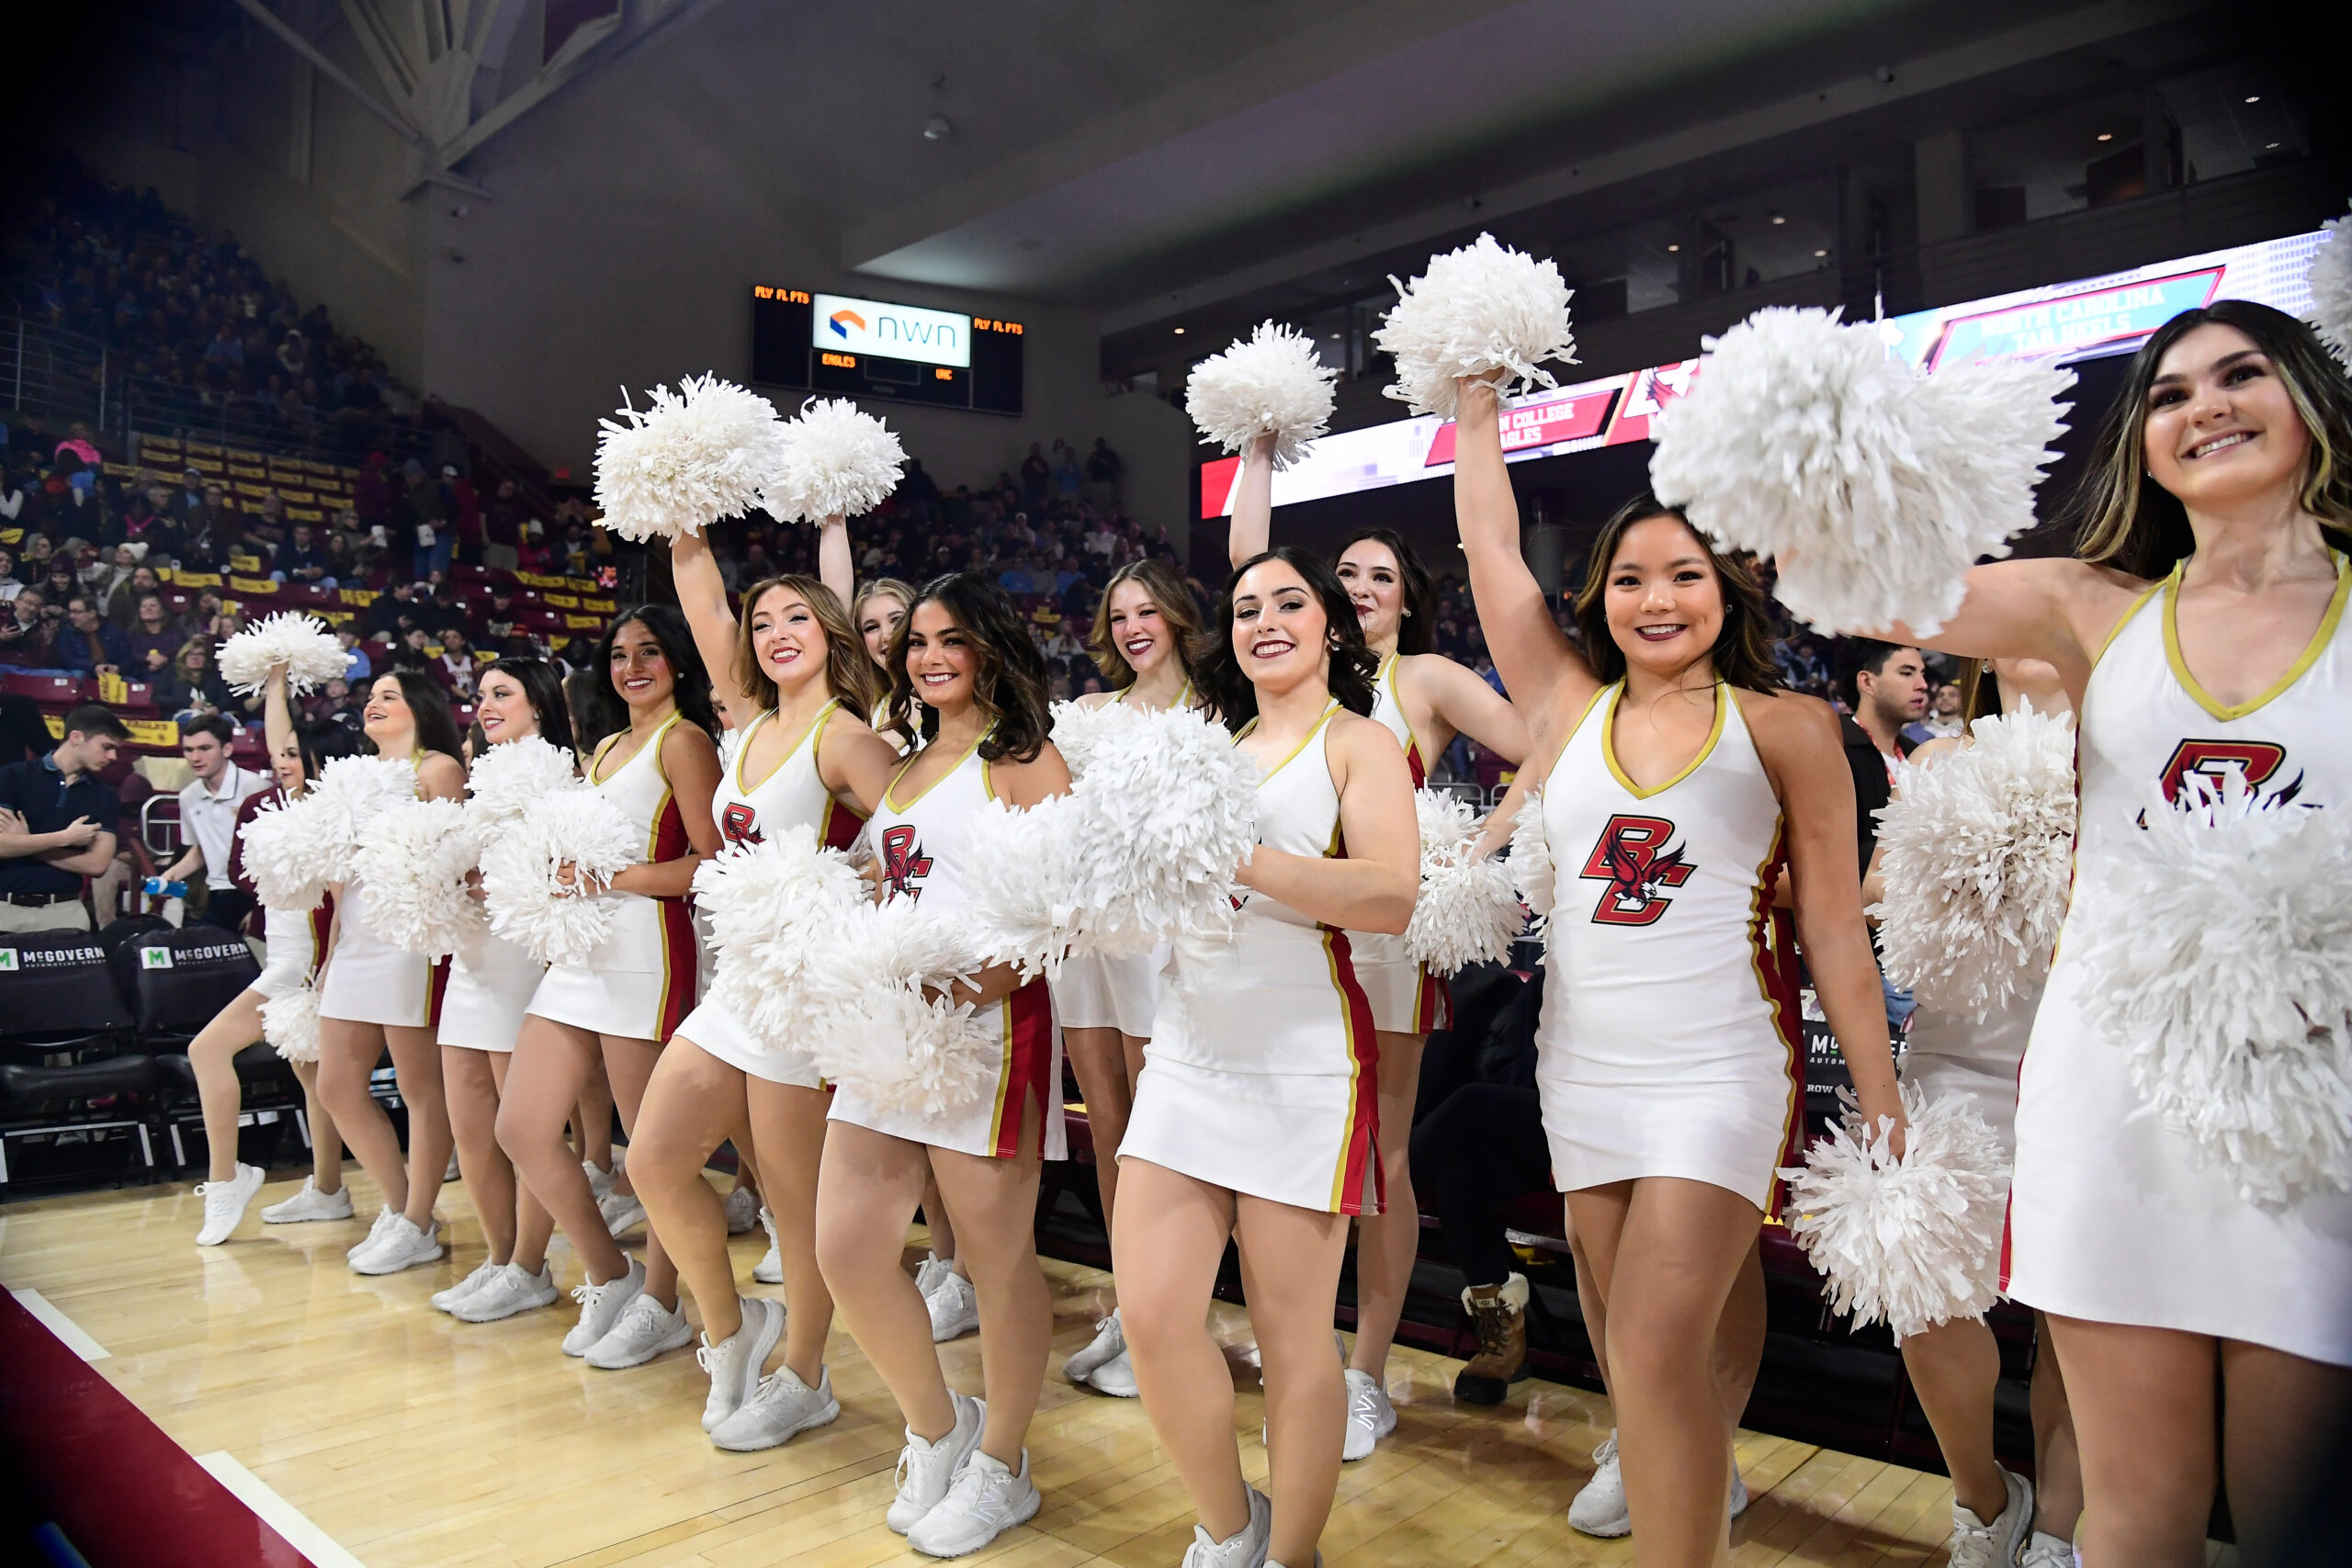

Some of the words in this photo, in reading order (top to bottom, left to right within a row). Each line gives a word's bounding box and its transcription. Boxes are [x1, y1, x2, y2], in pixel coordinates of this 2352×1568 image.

[790, 290, 809, 304] PTS
[1981, 309, 2051, 338] NORTH
[2056, 286, 2165, 321] CAROLINA
[878, 316, 956, 348] nwn
[1005, 322, 1023, 335] PTS
[2012, 328, 2058, 351] TAR
[2061, 313, 2132, 343] HEELS
[821, 353, 856, 368] EAGLES
[1513, 402, 1575, 428] COLLEGE
[1499, 426, 1543, 449] AGLES
[1806, 1084, 1834, 1094] ROW
